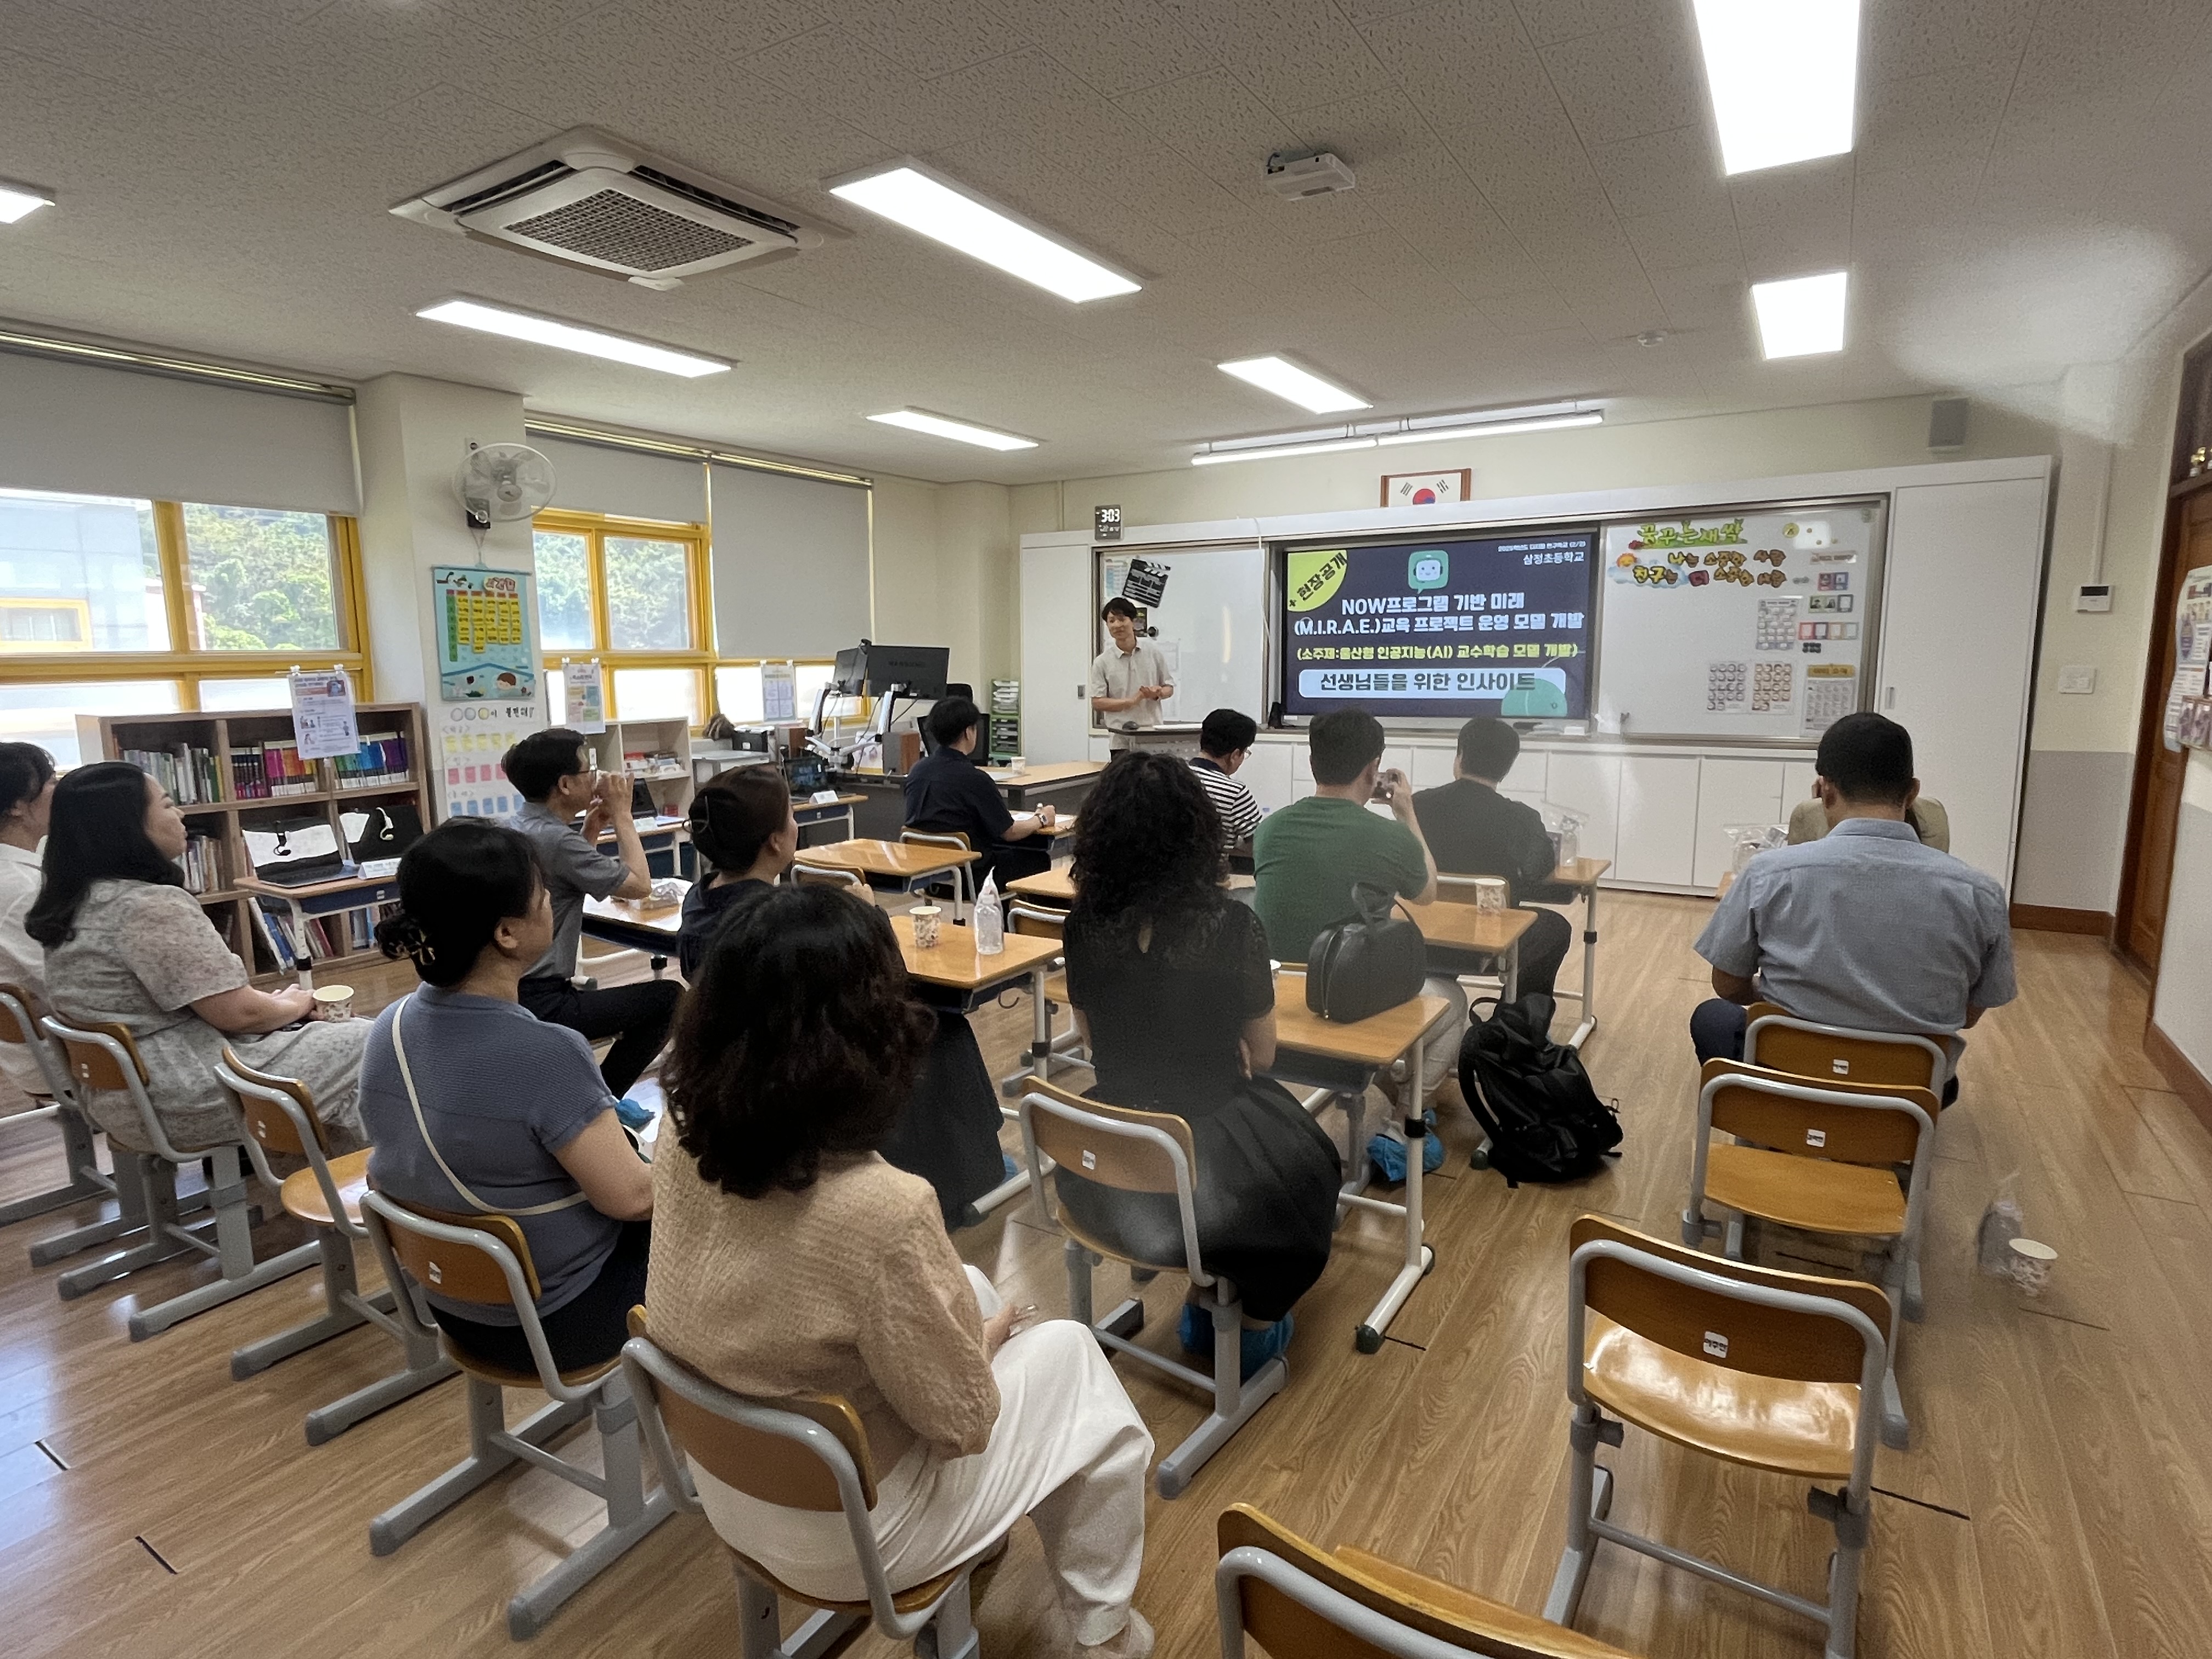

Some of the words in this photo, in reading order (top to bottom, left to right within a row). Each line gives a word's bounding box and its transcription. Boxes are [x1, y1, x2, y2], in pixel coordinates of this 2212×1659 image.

[1297, 552, 1347, 601] 현장공개
[1342, 595, 1449, 615] NOW프로그램
[1454, 594, 1487, 611] 기반
[1491, 592, 1524, 610] 미래
[1294, 617, 1410, 635] (M.I.R.A.E.)교육
[1414, 616, 1474, 633] 프로젝트
[1479, 614, 1509, 631] 운영
[1514, 613, 1546, 630] 모델
[1550, 612, 1585, 629] 개발
[1377, 645, 1453, 659] 인공지능(AI)
[1457, 645, 1509, 658] 교수학습
[1513, 644, 1540, 658] 모델
[1544, 643, 1578, 657] 개발)
[1321, 673, 1408, 691] 선생님들을
[1414, 673, 1451, 691] 위한
[1457, 673, 1535, 691] 인사이트
